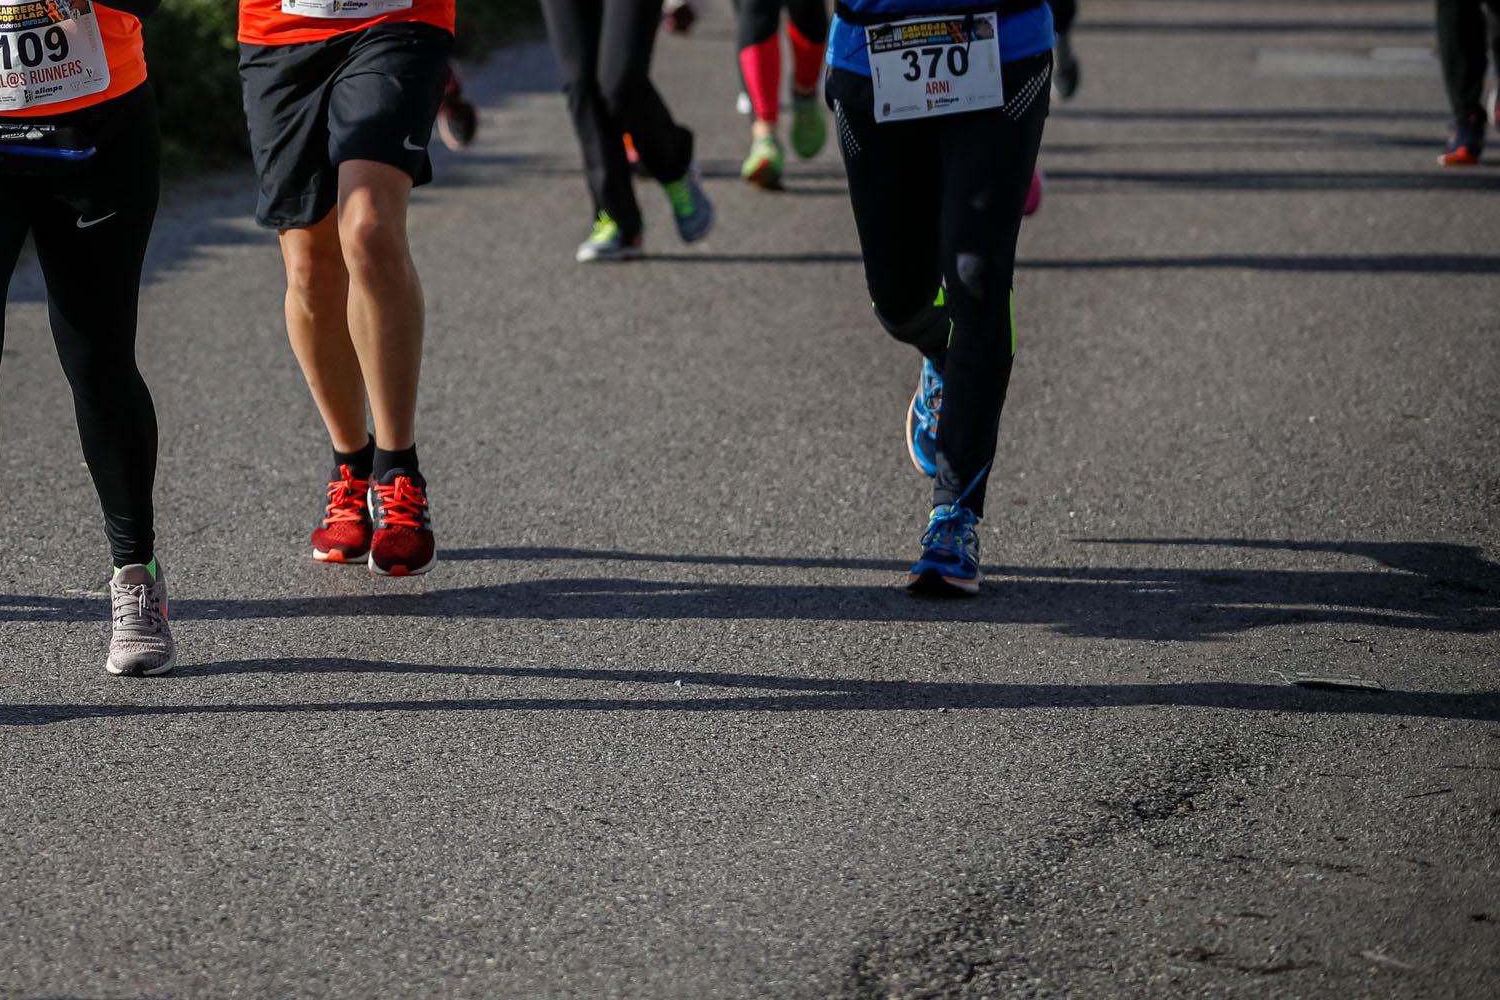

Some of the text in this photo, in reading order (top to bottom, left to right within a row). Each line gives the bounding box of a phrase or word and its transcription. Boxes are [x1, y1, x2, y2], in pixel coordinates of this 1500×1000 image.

[30, 59, 83, 85] RUNNERS
[901, 45, 969, 82] 370
[34, 83, 63, 95] olimpo
[925, 80, 950, 95] ARNI
